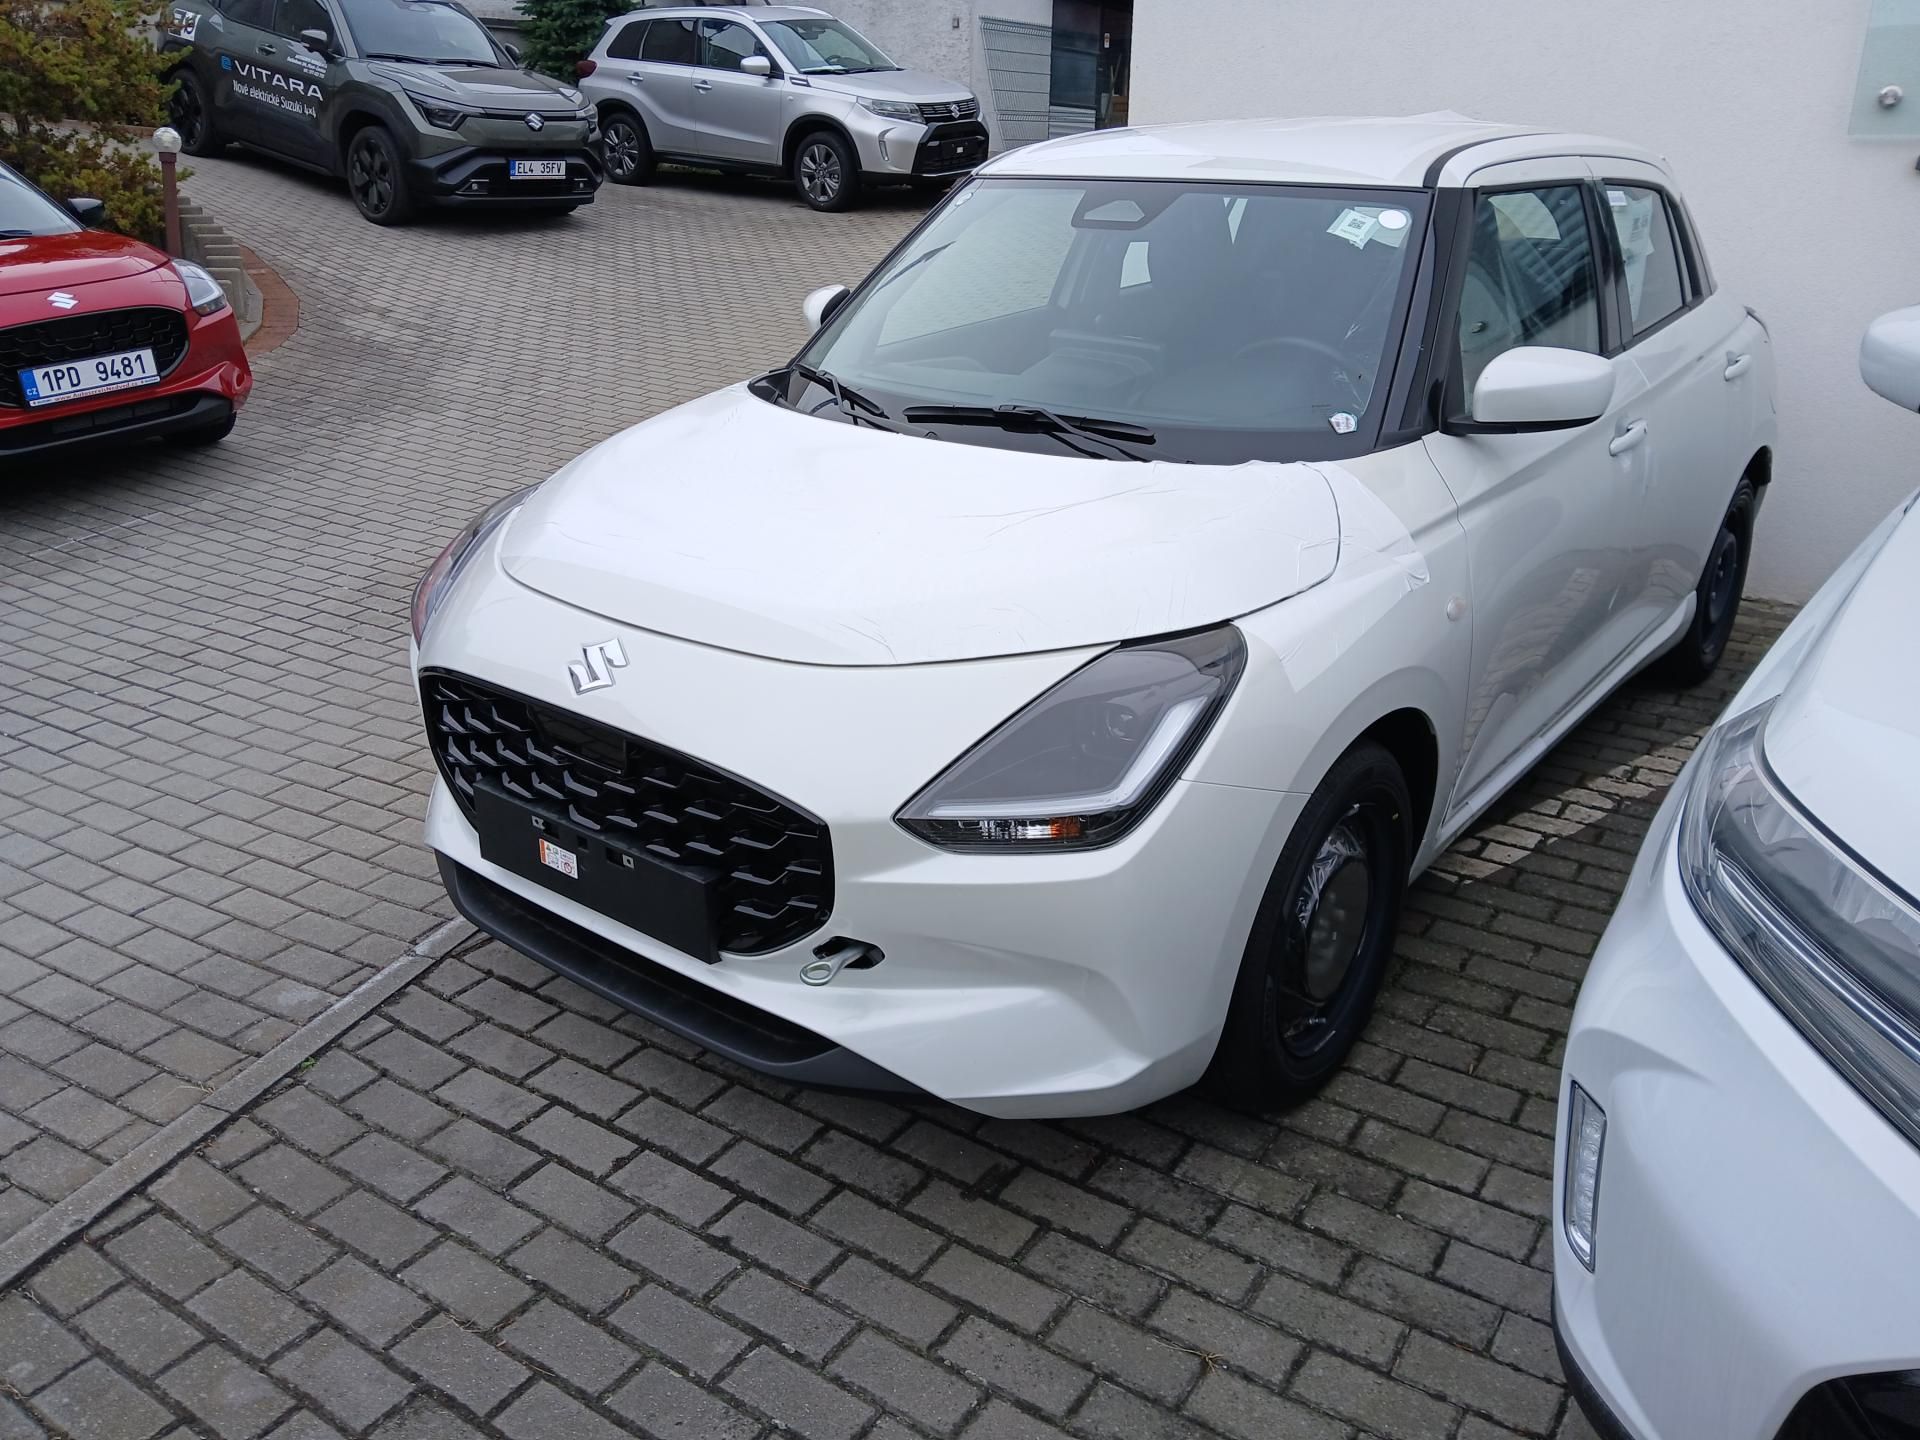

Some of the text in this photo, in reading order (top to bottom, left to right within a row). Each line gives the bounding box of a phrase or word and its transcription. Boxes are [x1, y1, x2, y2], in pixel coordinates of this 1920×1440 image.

[232, 79, 249, 96] Nové
[249, 86, 280, 107] elektrické
[280, 95, 303, 114] Suzuki
[234, 60, 323, 101] VITARA
[517, 162, 562, 174] EL4 35FV
[42, 353, 146, 392] 1PD 9481
[26, 388, 39, 396] CZ
